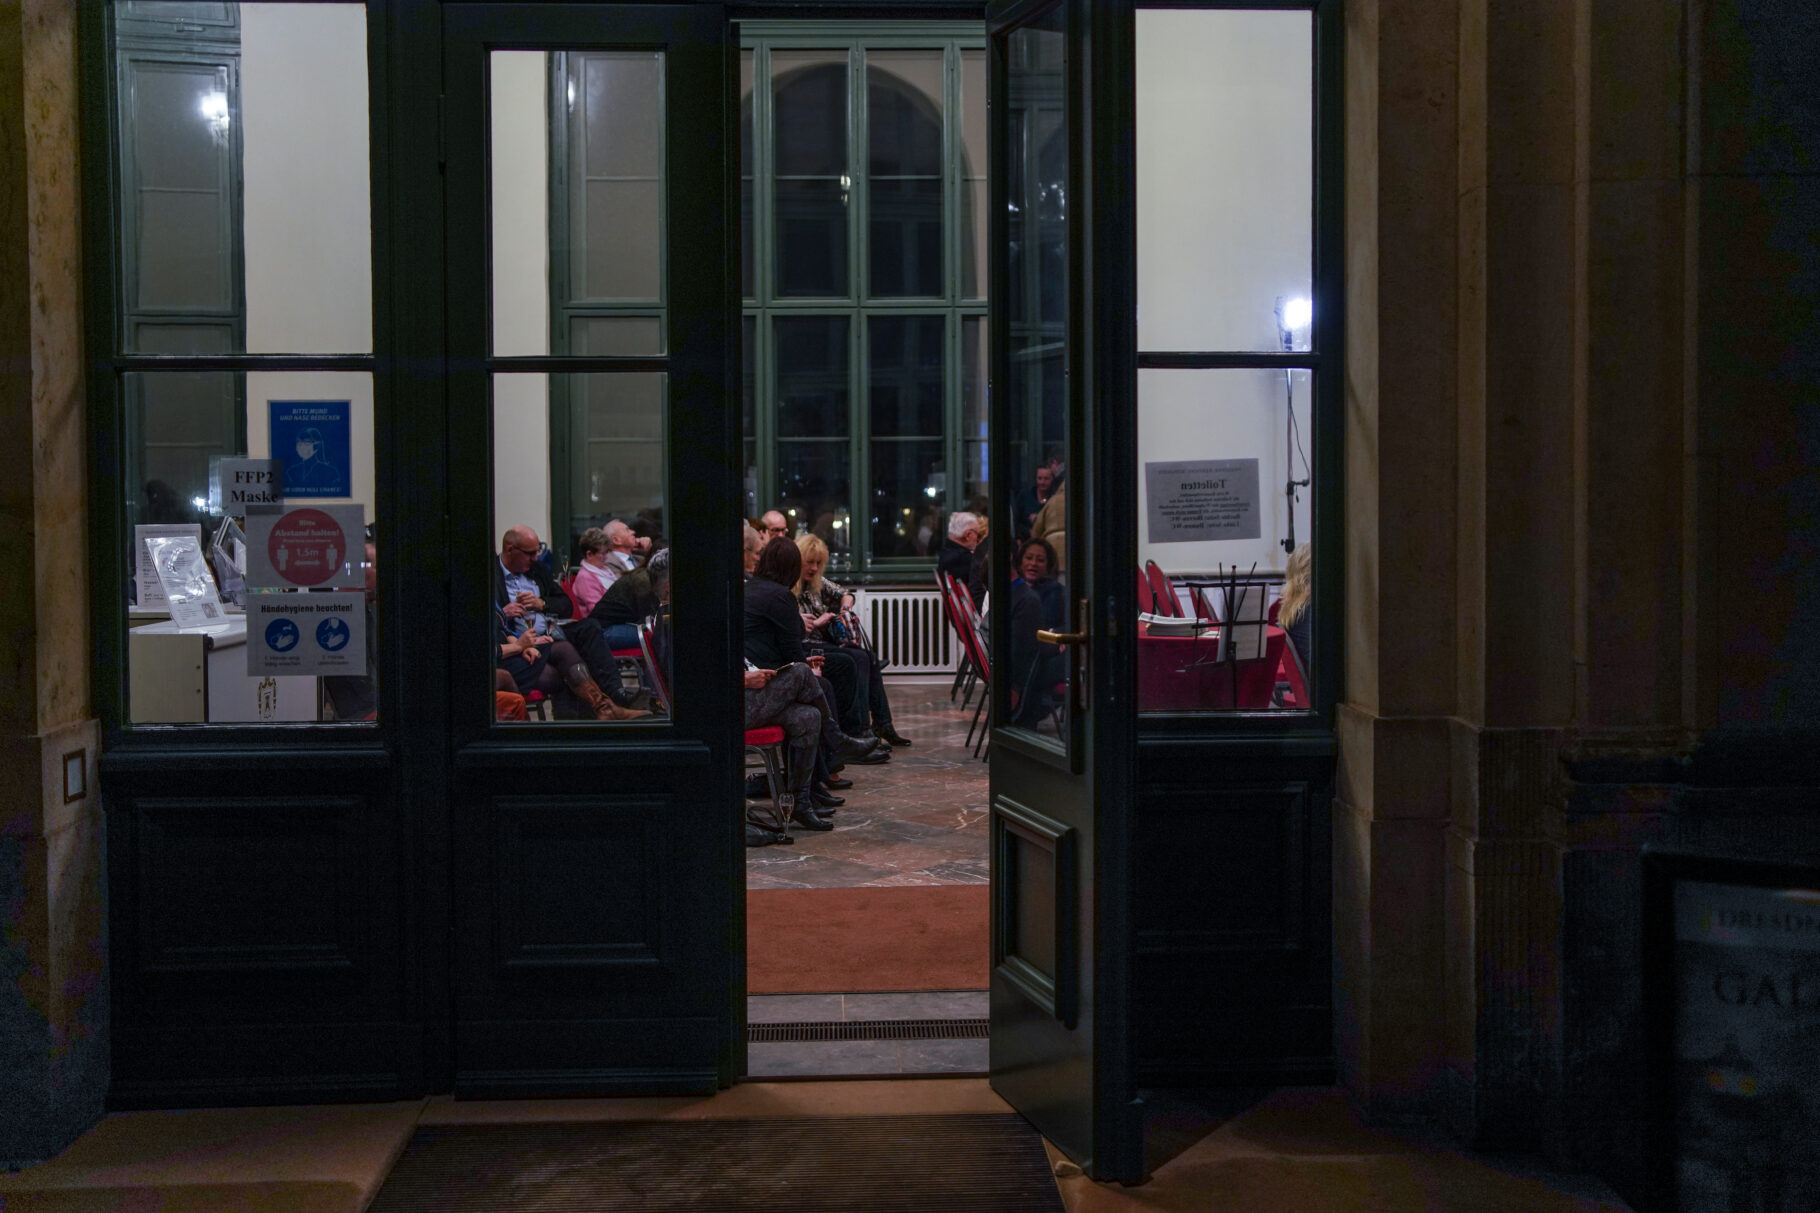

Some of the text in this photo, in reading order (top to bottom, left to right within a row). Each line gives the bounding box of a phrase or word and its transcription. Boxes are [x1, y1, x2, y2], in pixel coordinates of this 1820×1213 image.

[234, 471, 274, 484] FFP2
[231, 490, 279, 503] Maske
[275, 528, 339, 537] Abstand halten!
[261, 603, 353, 615] Händehygiene beachten!
